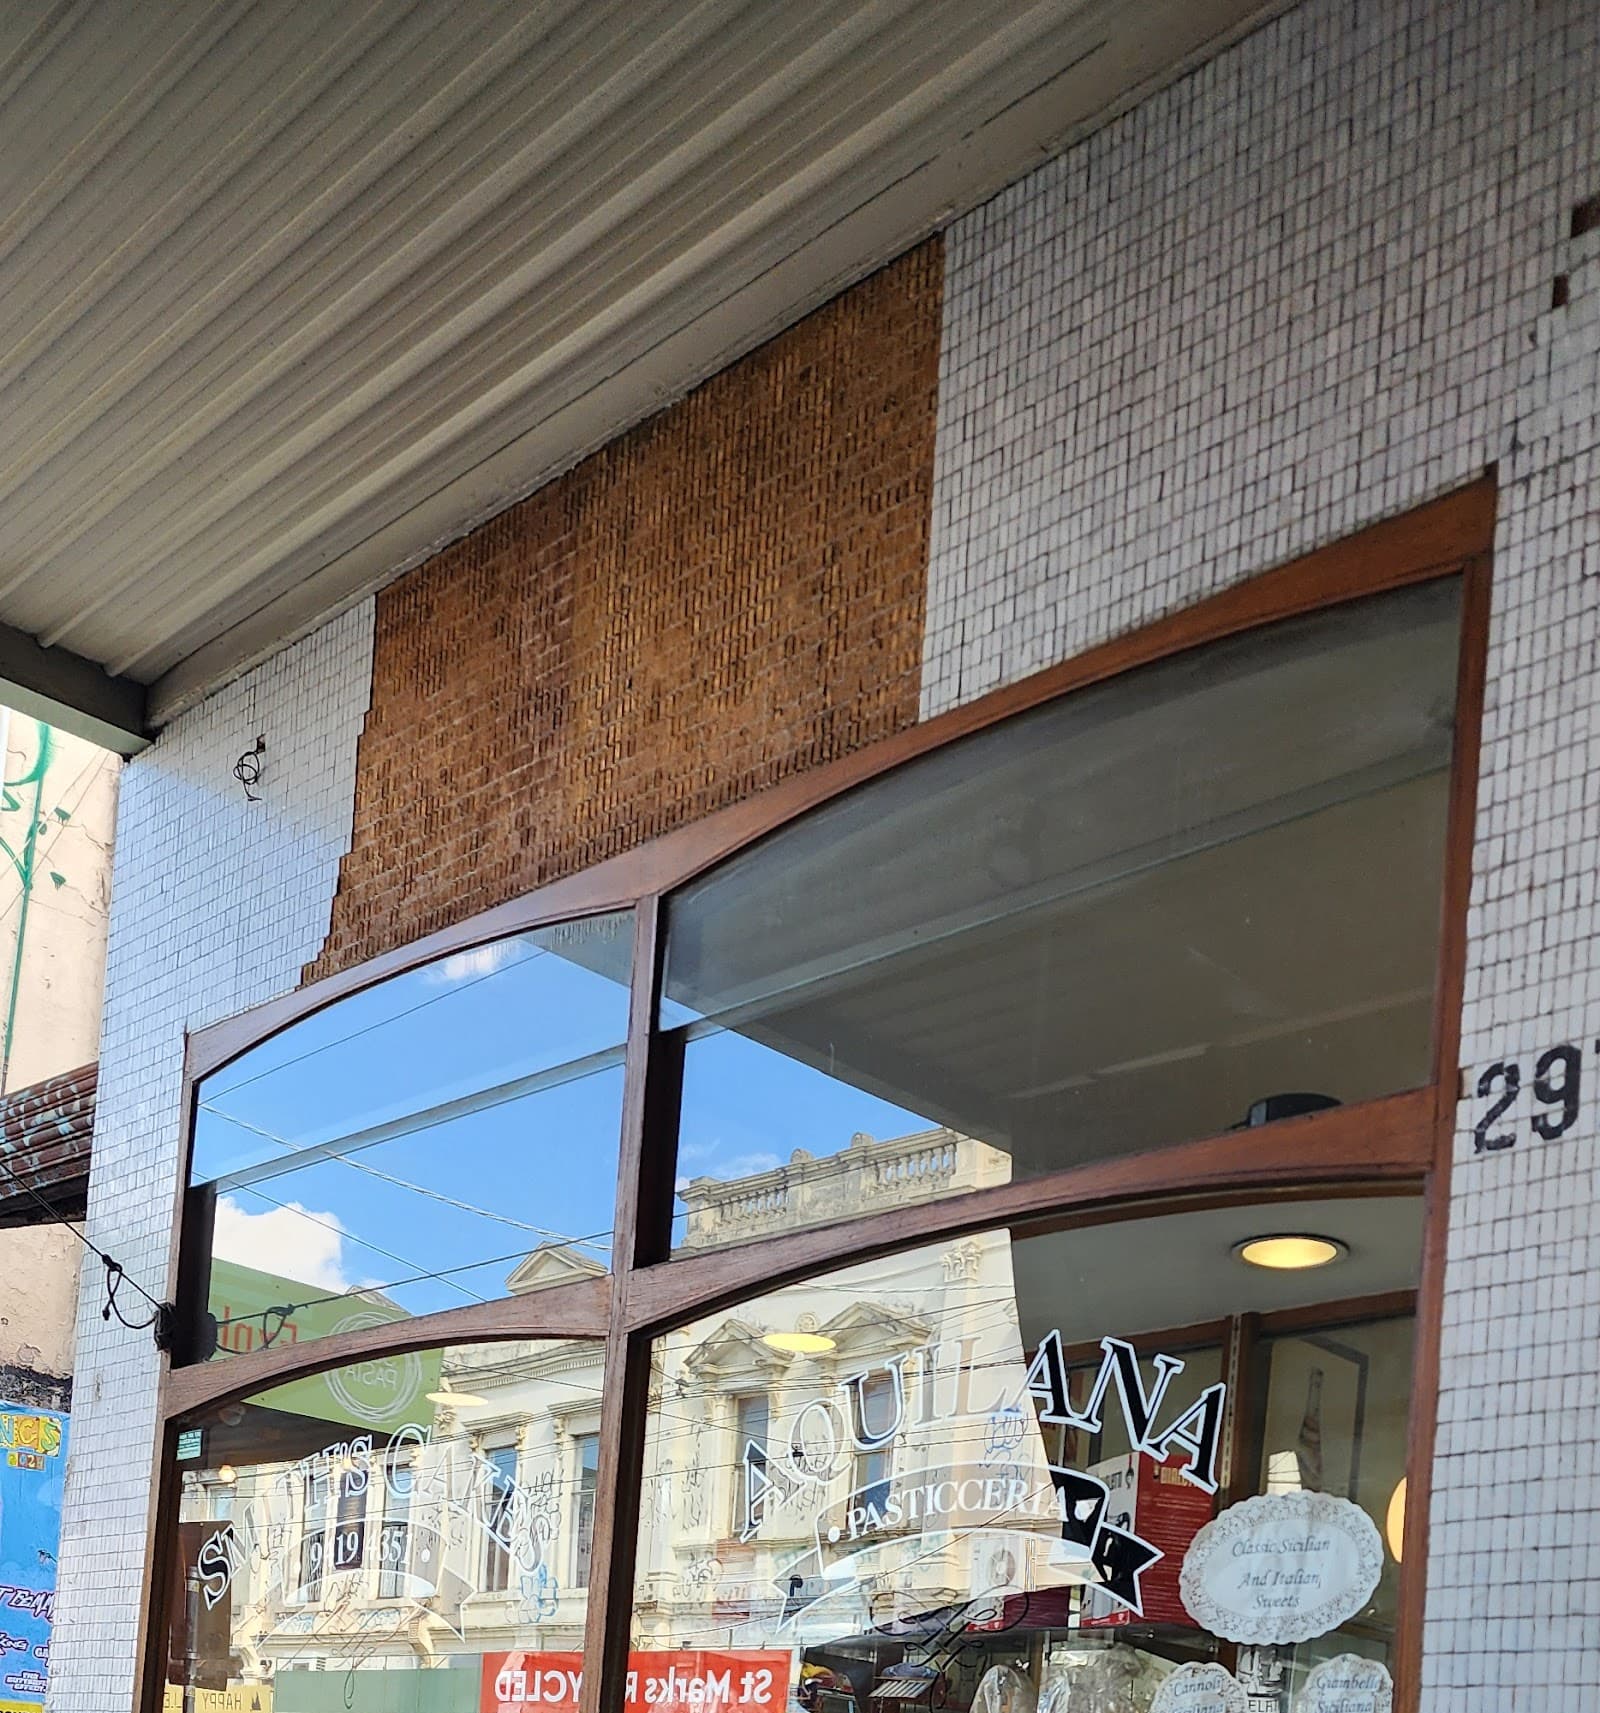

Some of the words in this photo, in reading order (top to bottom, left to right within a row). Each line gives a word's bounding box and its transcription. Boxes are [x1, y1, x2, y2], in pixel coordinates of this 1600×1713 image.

[1474, 1038, 1600, 1154] 29
[739, 1328, 1227, 1544] AQUILANA
[847, 1478, 1070, 1542] PASTICCERIA
[1232, 1539, 1274, 1557] Classic
[1278, 1535, 1331, 1554] Sicilian
[1237, 1570, 1267, 1589] And
[1252, 1594, 1300, 1610] Sweets
[1174, 1675, 1222, 1697] Cannoli
